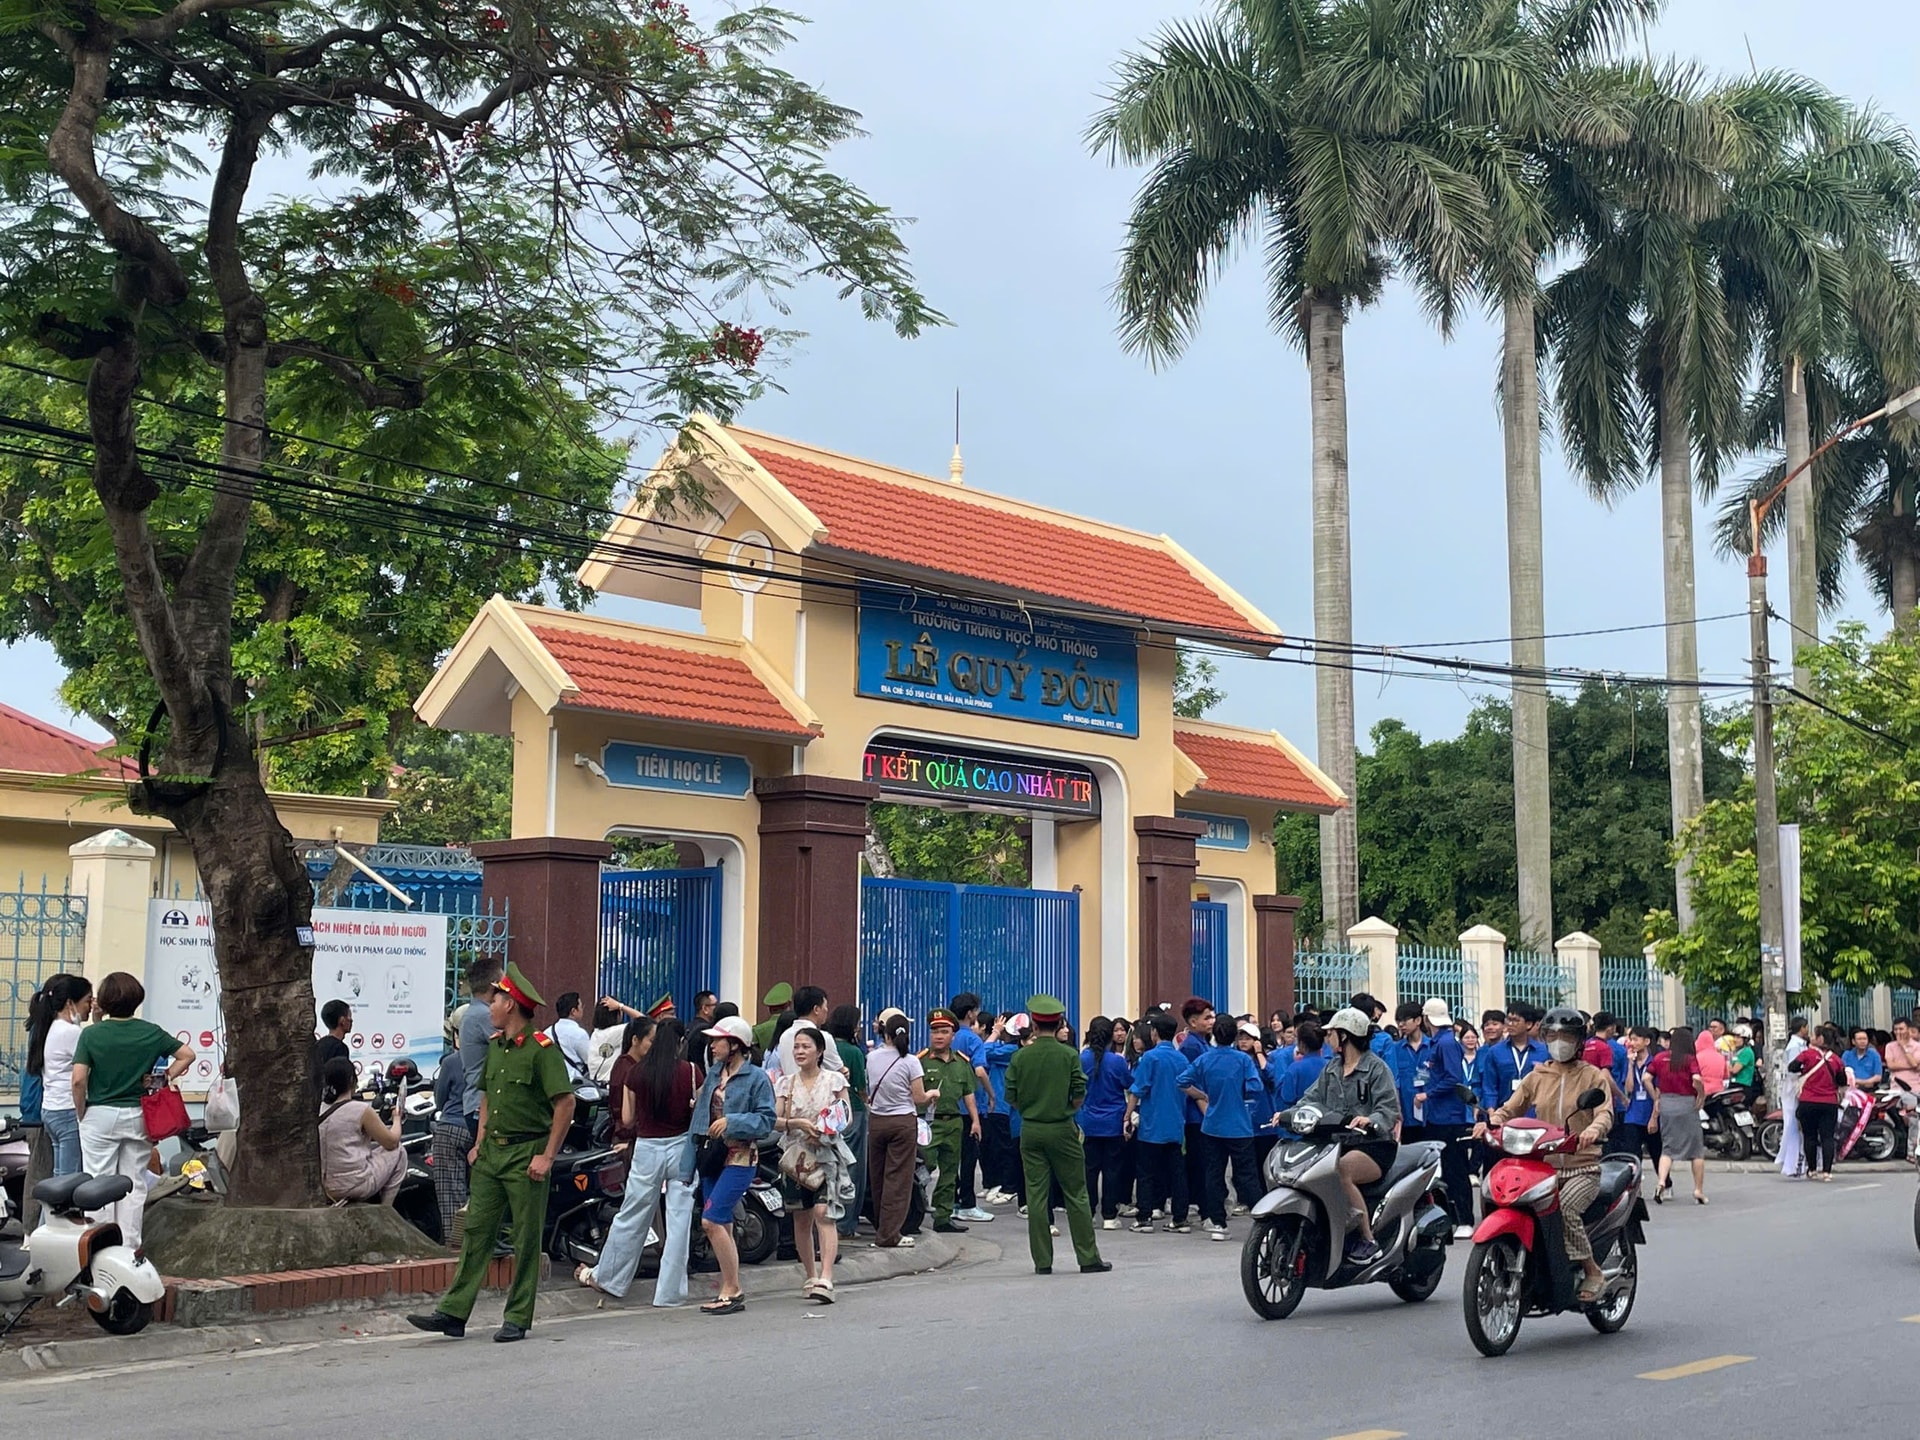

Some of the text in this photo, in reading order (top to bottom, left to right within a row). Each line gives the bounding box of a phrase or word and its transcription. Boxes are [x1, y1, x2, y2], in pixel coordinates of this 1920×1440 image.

[912, 610, 1098, 659] TRƯỜNG TRUNG HỌC PHỔ THÔNG
[885, 631, 1121, 716] LÊ QUÝ ĐÔN
[673, 760, 703, 786] HỌC
[880, 749, 922, 783] KẾT
[925, 758, 969, 792] QUẢ
[972, 766, 1013, 794] CAO
[1016, 769, 1069, 800] NHẤT
[159, 936, 177, 947] HỌC
[179, 936, 198, 947] SINH
[340, 944, 353, 954] VỚI
[354, 945, 361, 954] VI
[362, 946, 384, 957] PHẠM
[384, 947, 402, 957] GIAO
[403, 946, 427, 957] THÔNG
[312, 919, 331, 934] ÁCH
[333, 920, 361, 937] NHIỆM
[364, 920, 381, 936] CỦA
[383, 921, 399, 937] MỖI
[401, 924, 427, 938] NGƯỜI
